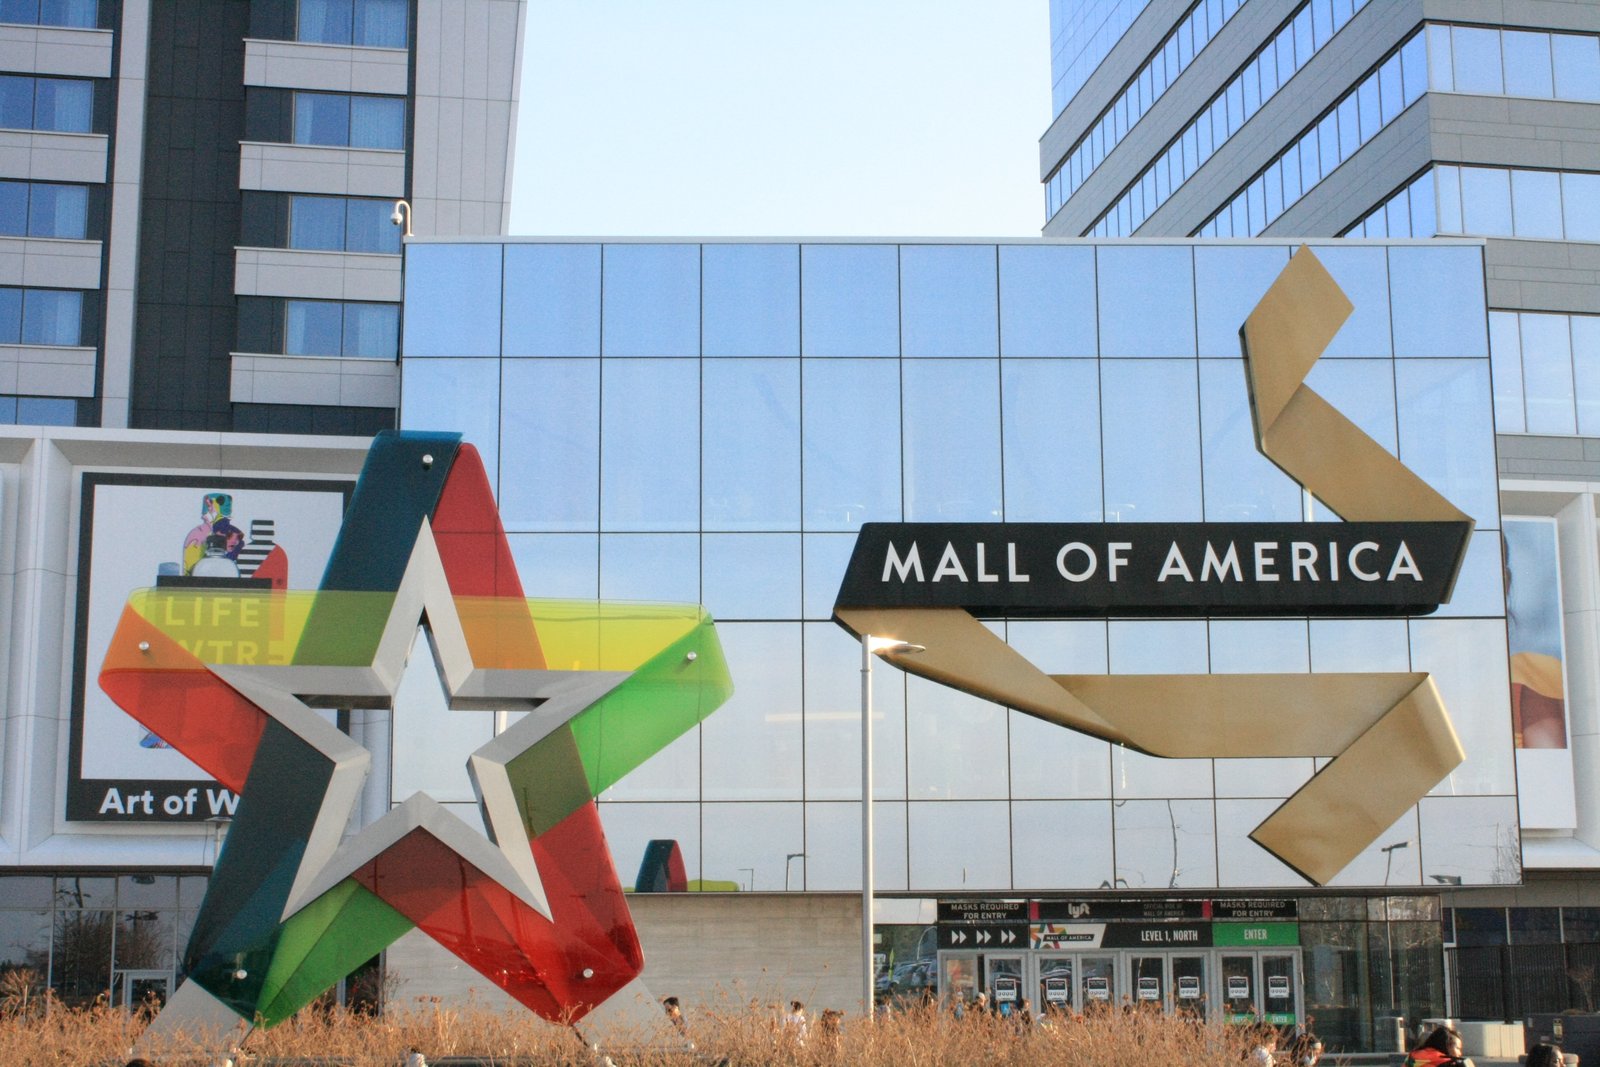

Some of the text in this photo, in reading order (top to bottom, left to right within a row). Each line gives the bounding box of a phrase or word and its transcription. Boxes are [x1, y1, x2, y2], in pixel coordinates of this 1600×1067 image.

[881, 540, 1424, 583] MALL OF AMERICA
[165, 596, 260, 627] LIFE
[98, 787, 154, 815] Art
[163, 787, 198, 816] of
[951, 903, 1019, 911] MASKS REQUIRED
[1220, 901, 1246, 909] MASKS
[1141, 930, 1198, 942] LEVEL 1, NORTH
[1244, 929, 1267, 940] ENTER
